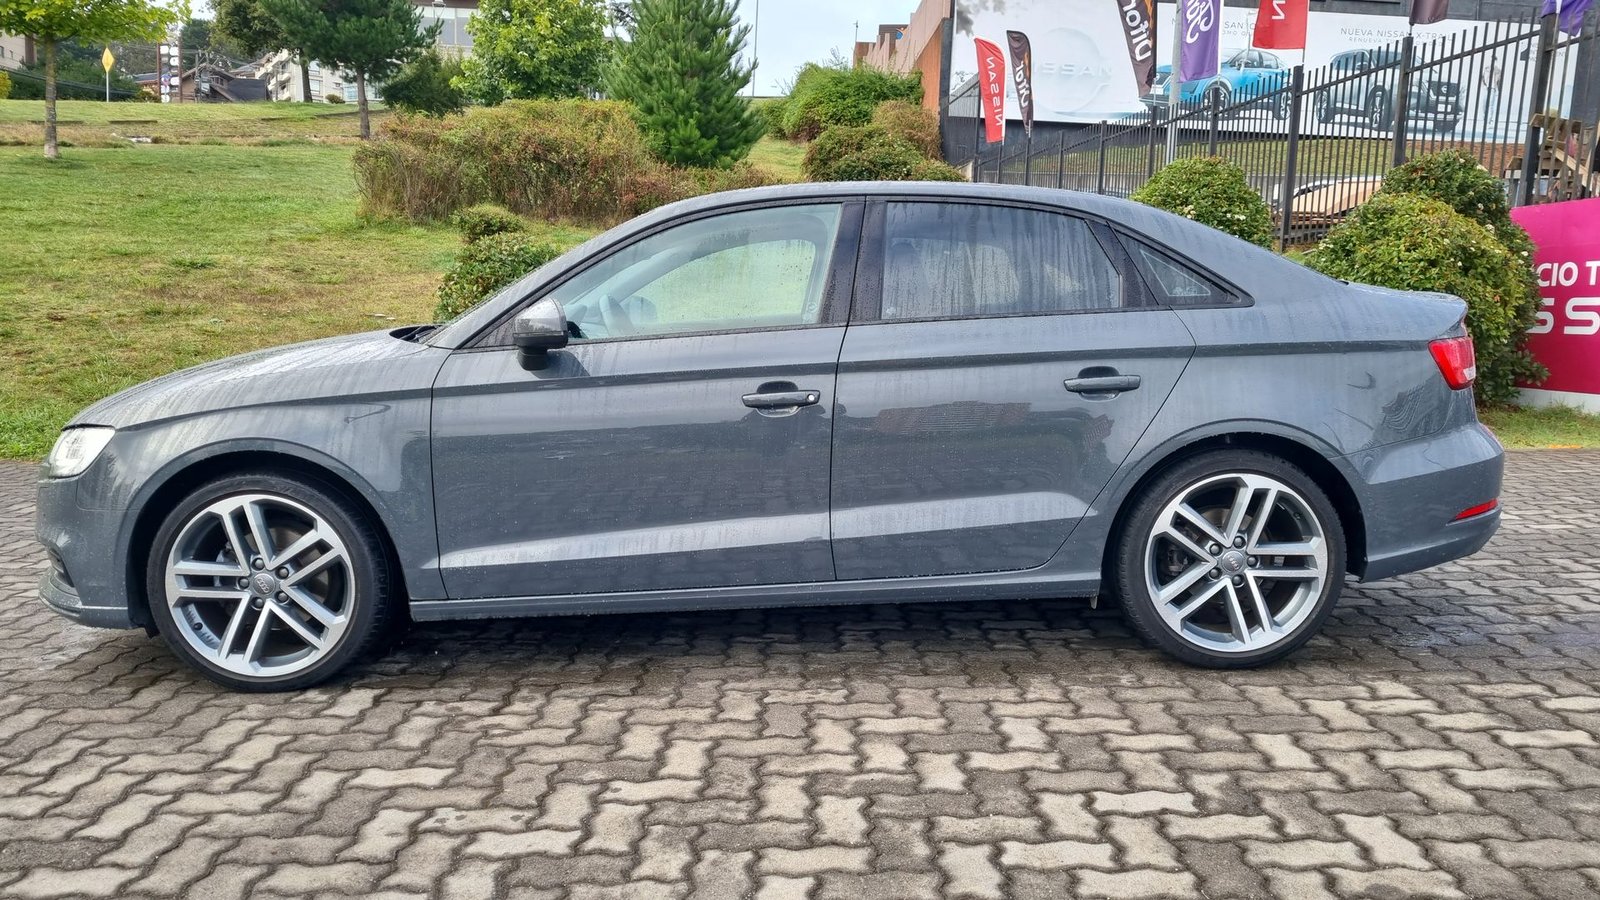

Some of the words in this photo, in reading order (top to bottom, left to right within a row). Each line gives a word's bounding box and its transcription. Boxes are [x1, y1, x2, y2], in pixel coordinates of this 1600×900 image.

[1340, 27, 1372, 36] NUEVA
[1033, 62, 1113, 80] ISSAN
[1536, 262, 1579, 287] CIO
